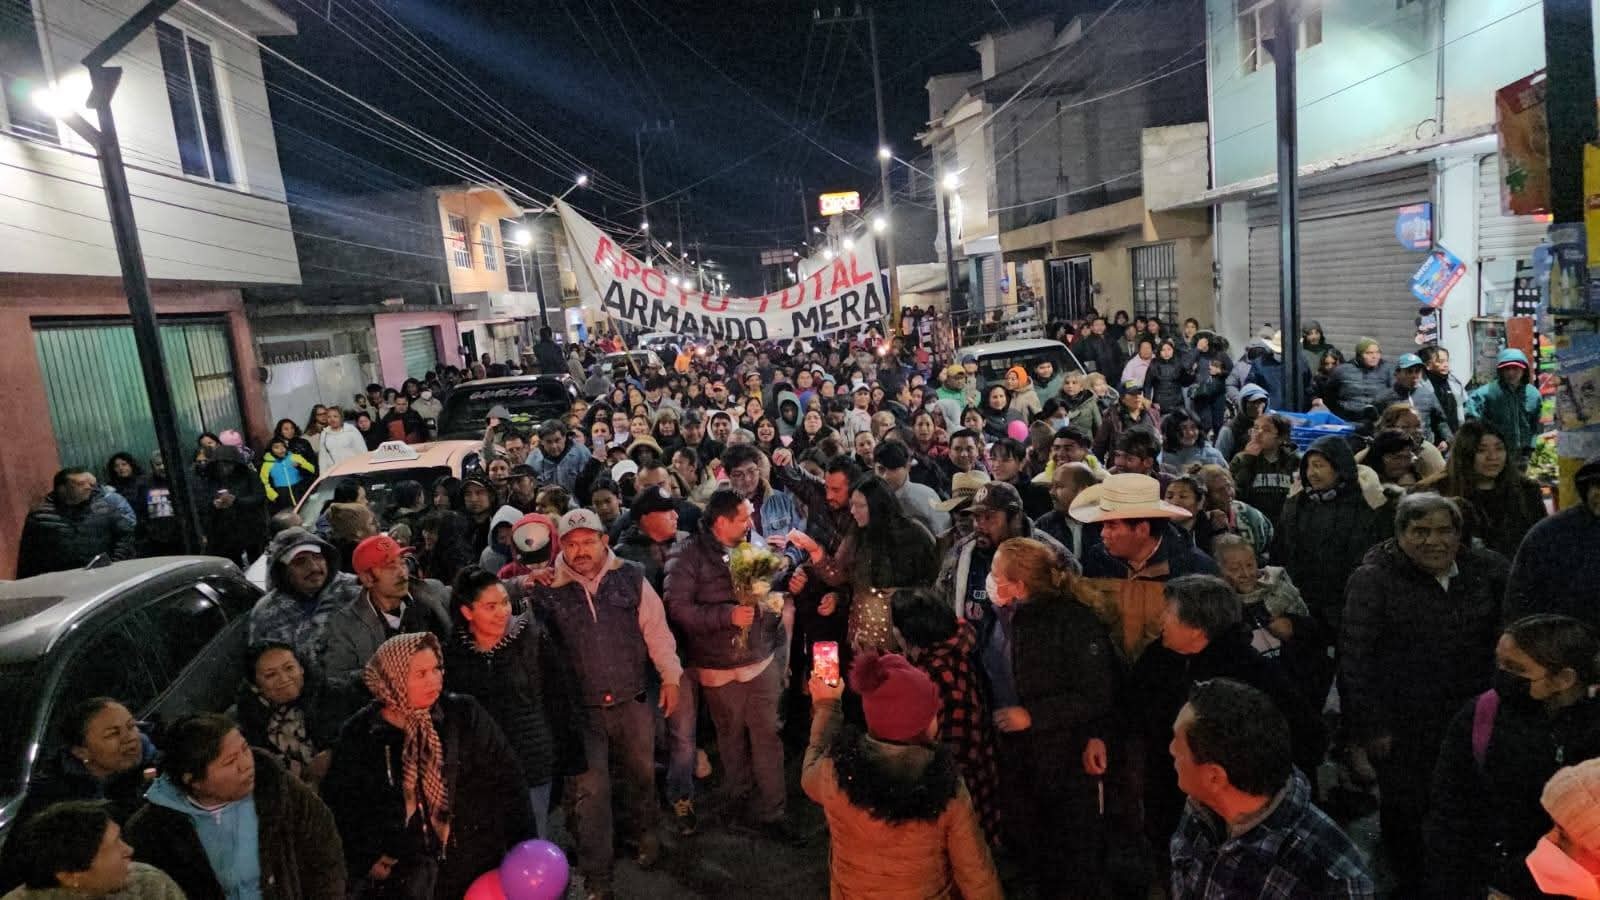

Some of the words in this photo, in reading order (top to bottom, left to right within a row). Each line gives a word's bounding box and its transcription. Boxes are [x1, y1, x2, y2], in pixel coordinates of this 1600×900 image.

[595, 236, 730, 312] APOYO
[750, 251, 874, 313] TOTAL
[601, 279, 769, 341] ARMANDO
[792, 282, 882, 337] MERA
